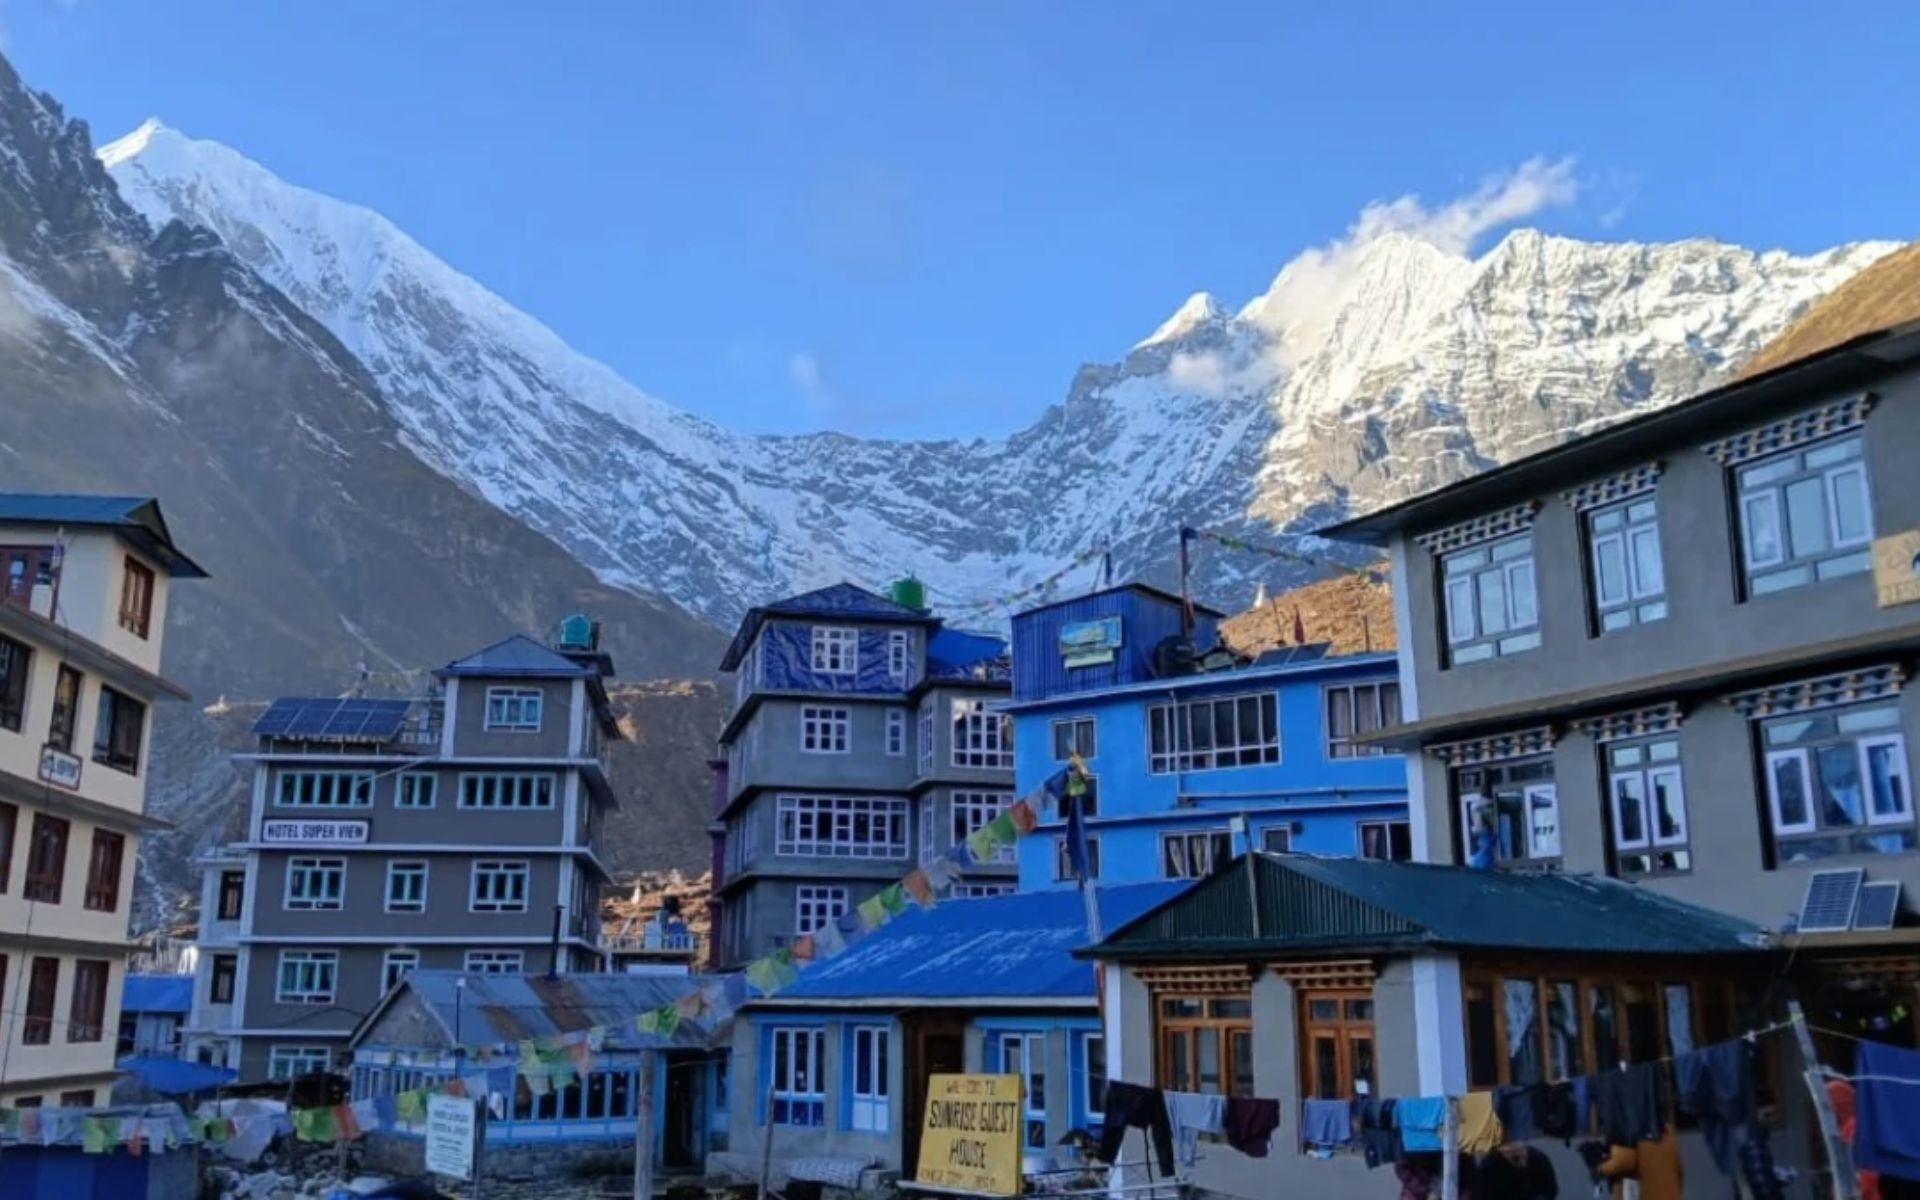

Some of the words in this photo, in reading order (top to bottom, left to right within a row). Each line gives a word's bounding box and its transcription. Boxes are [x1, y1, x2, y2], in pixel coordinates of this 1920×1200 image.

[268, 824, 298, 838] HOTEL
[302, 824, 335, 839] SUPER
[339, 824, 364, 839] VIEW
[929, 1100, 977, 1131] SUNRISE
[980, 1101, 1016, 1133] GUEST
[949, 1138, 986, 1168] HOUSE
